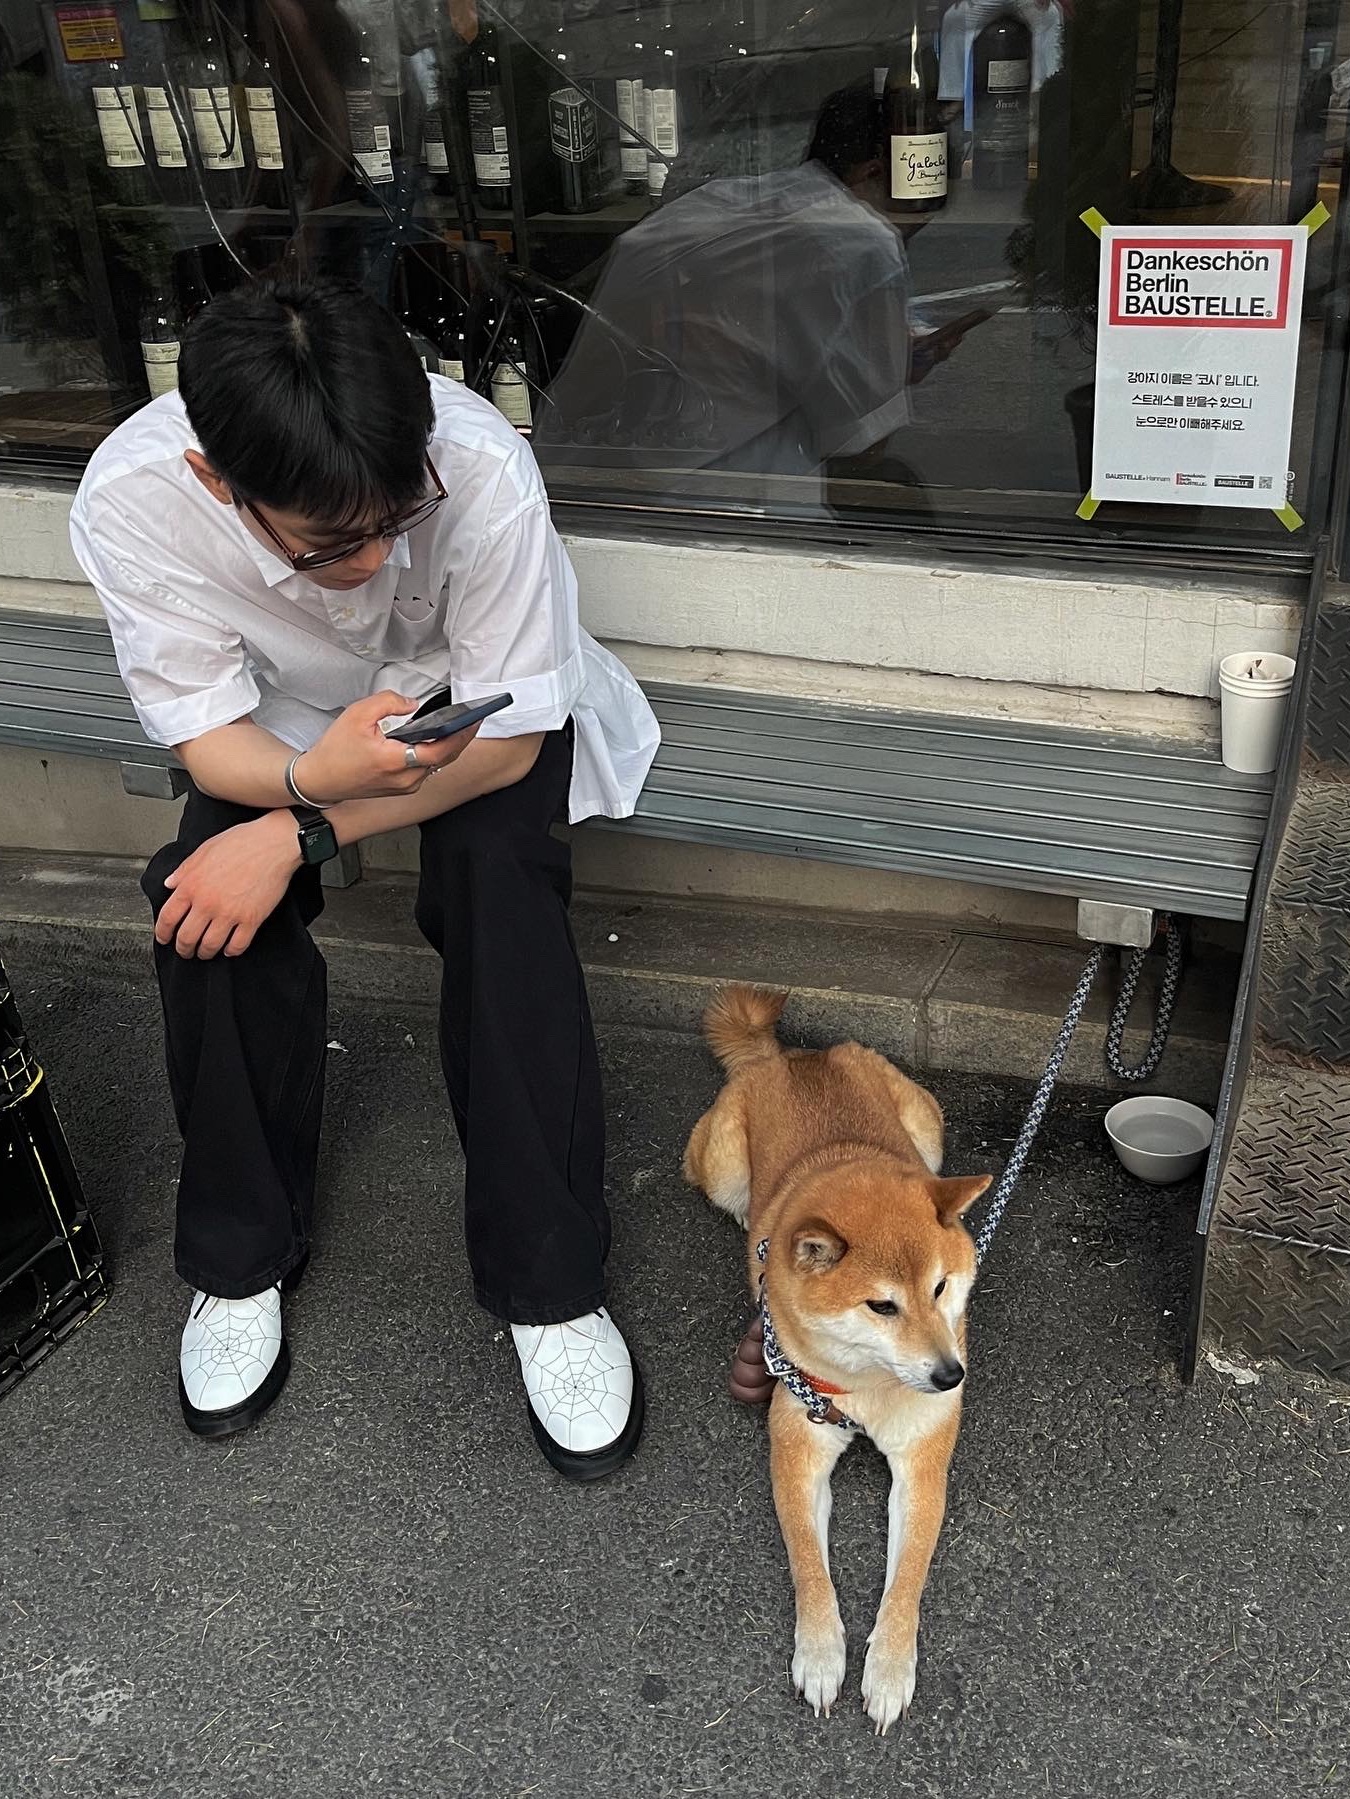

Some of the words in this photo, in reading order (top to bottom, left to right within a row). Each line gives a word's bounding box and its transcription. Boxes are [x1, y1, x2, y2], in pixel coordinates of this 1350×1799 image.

[1127, 250, 1270, 271] Dankeschön
[1126, 273, 1189, 293] Berlin
[1127, 371, 1159, 384] 강아지
[1224, 374, 1260, 387] 입니다.
[1219, 396, 1253, 409] 있으니
[1136, 416, 1178, 429] 눈으로만
